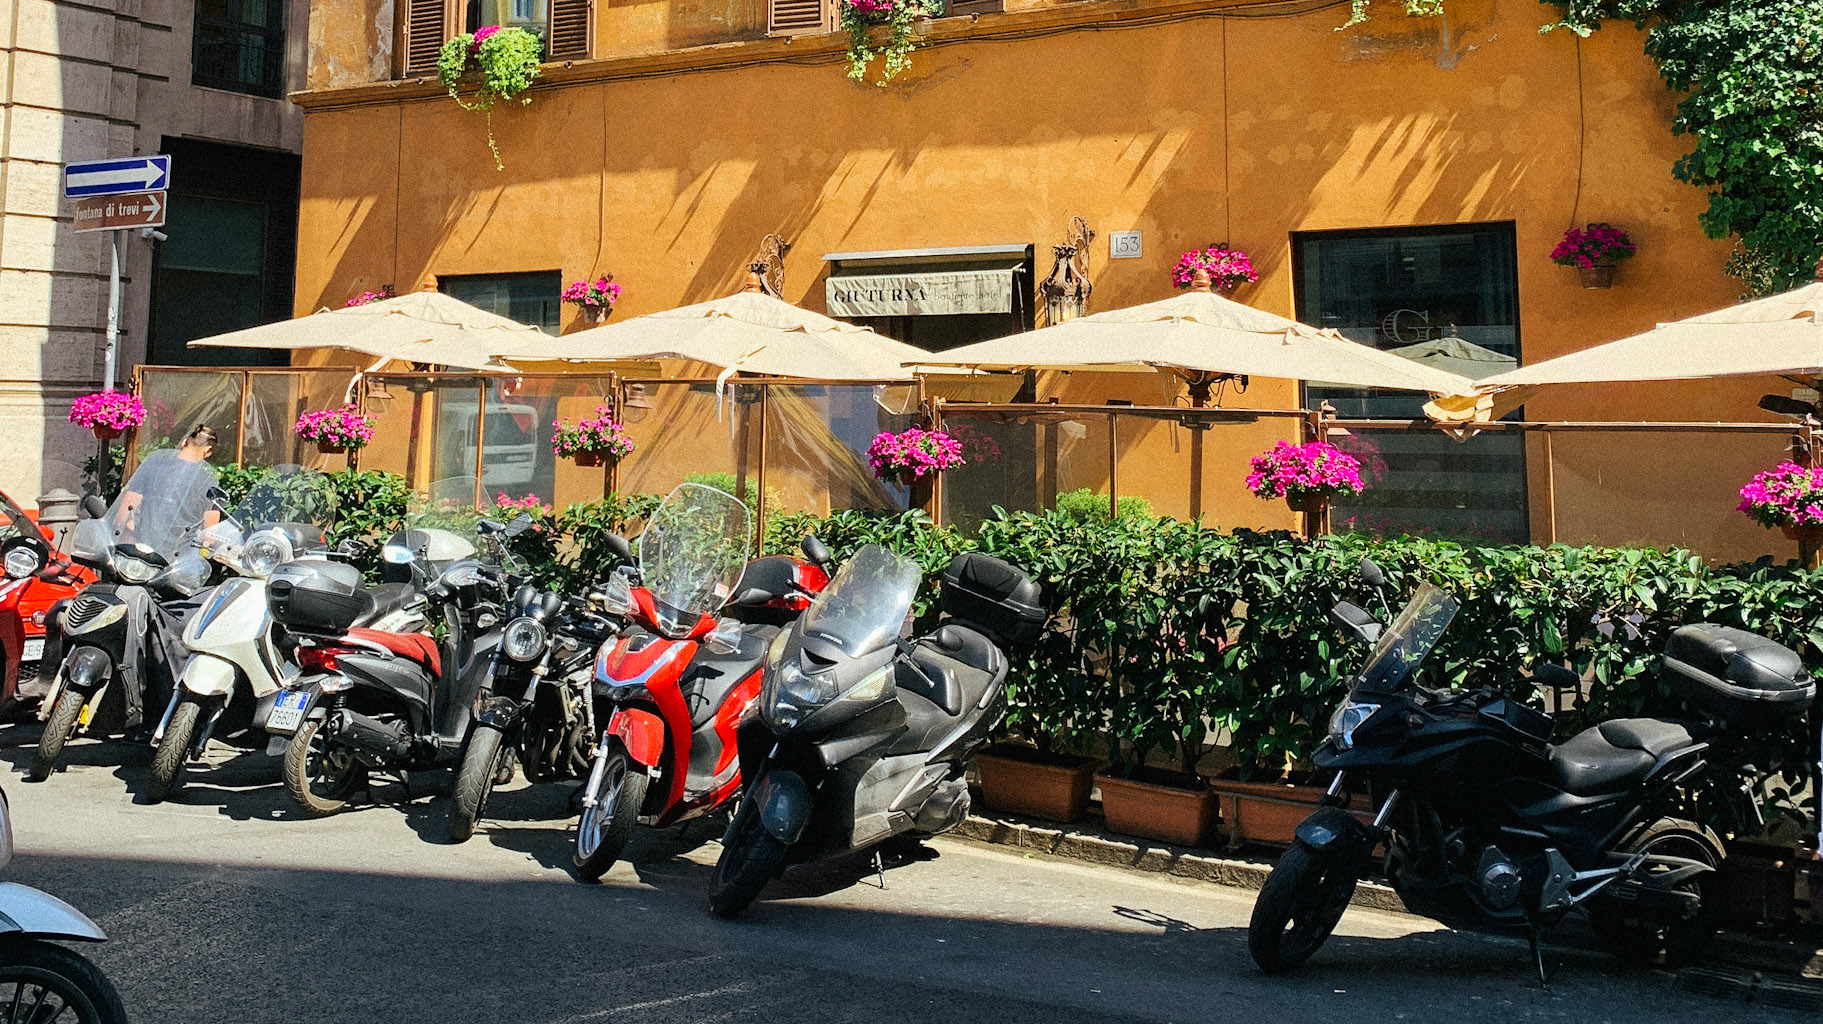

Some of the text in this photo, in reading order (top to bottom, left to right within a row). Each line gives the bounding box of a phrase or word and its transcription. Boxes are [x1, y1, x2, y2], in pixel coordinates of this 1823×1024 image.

[76, 200, 140, 221] fontana di trevi
[1115, 236, 1139, 253] 153
[834, 285, 1002, 307] GIUTURNA boutique hotel
[1383, 309, 1432, 343] G
